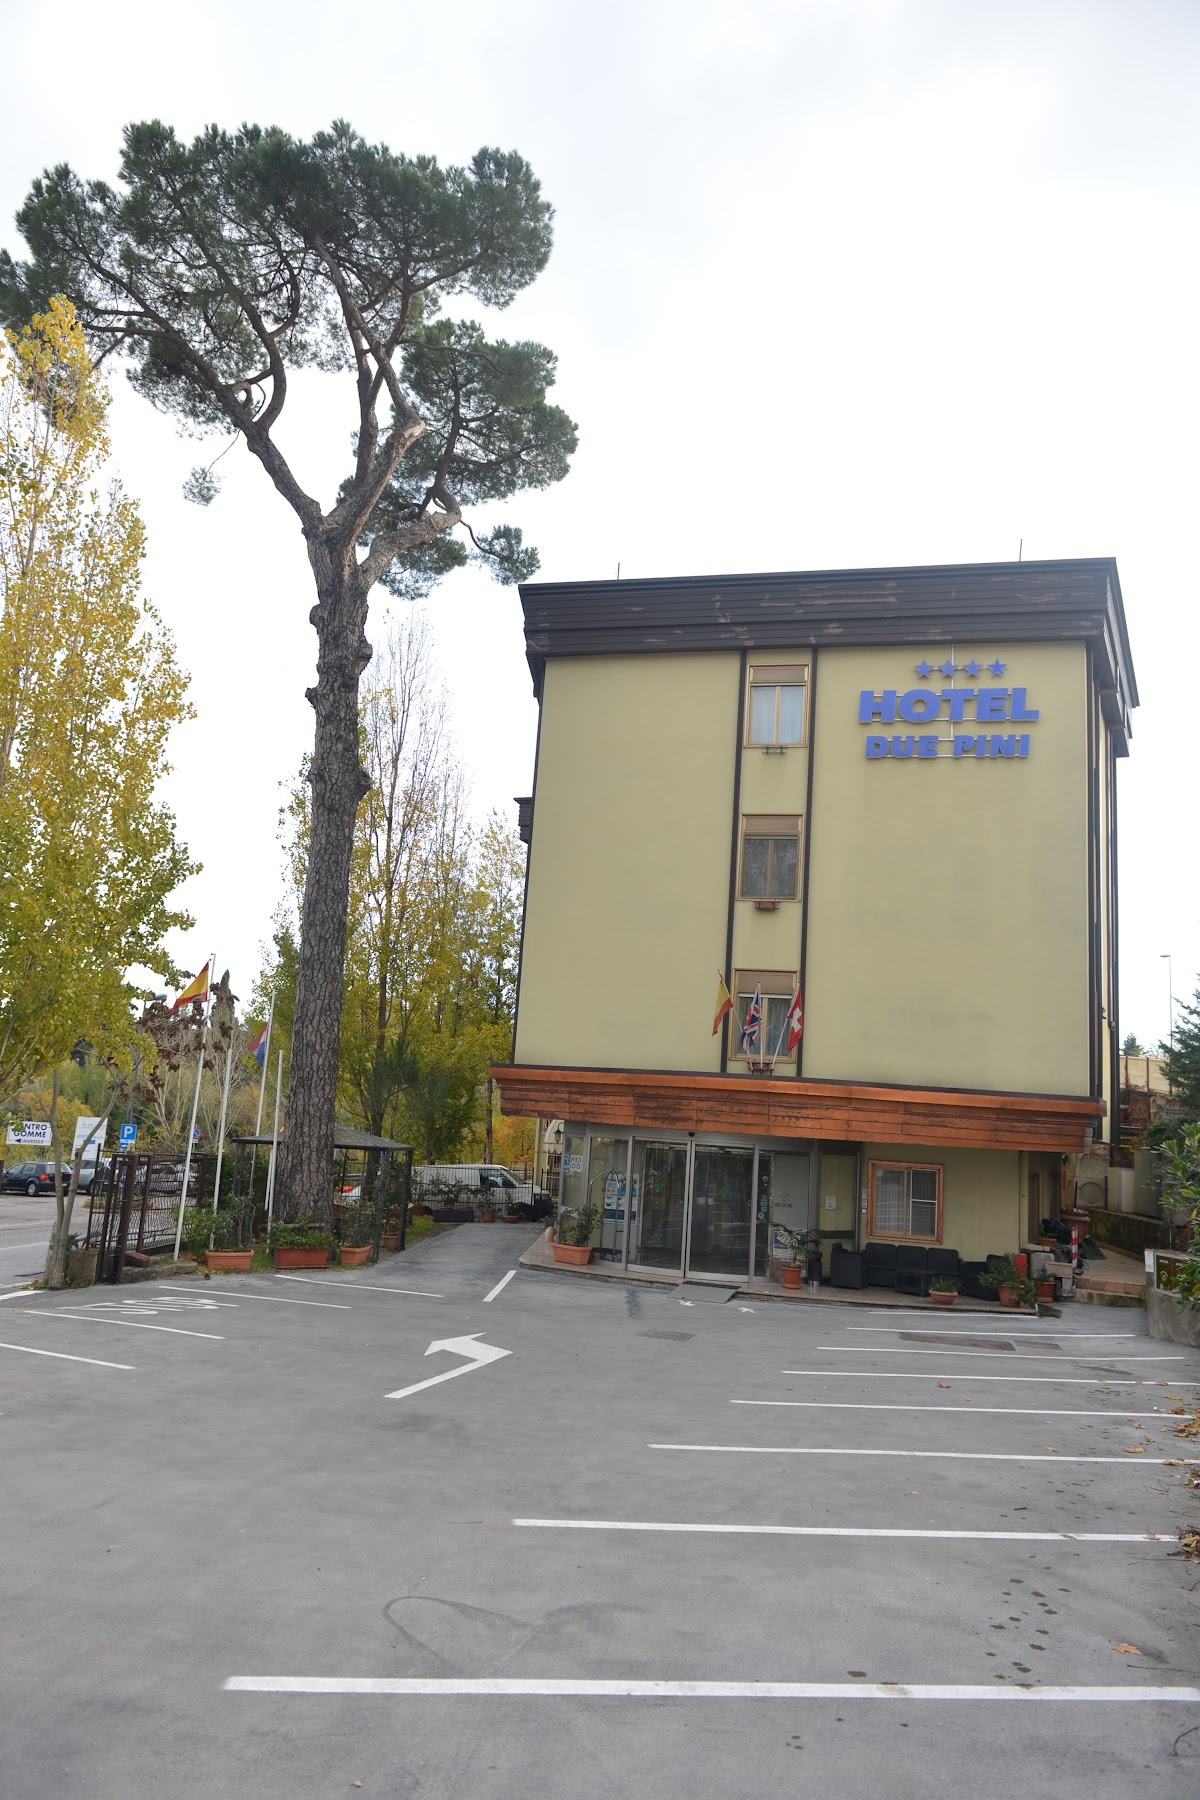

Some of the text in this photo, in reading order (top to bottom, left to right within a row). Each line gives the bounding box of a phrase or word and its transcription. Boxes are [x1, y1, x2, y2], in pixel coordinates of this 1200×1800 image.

[858, 688, 1040, 724] HOTEL
[865, 734, 1030, 759] DUE PINI
[24, 1123, 48, 1131] NTRO
[123, 1125, 134, 1138] P
[13, 1130, 47, 1138] GOMME
